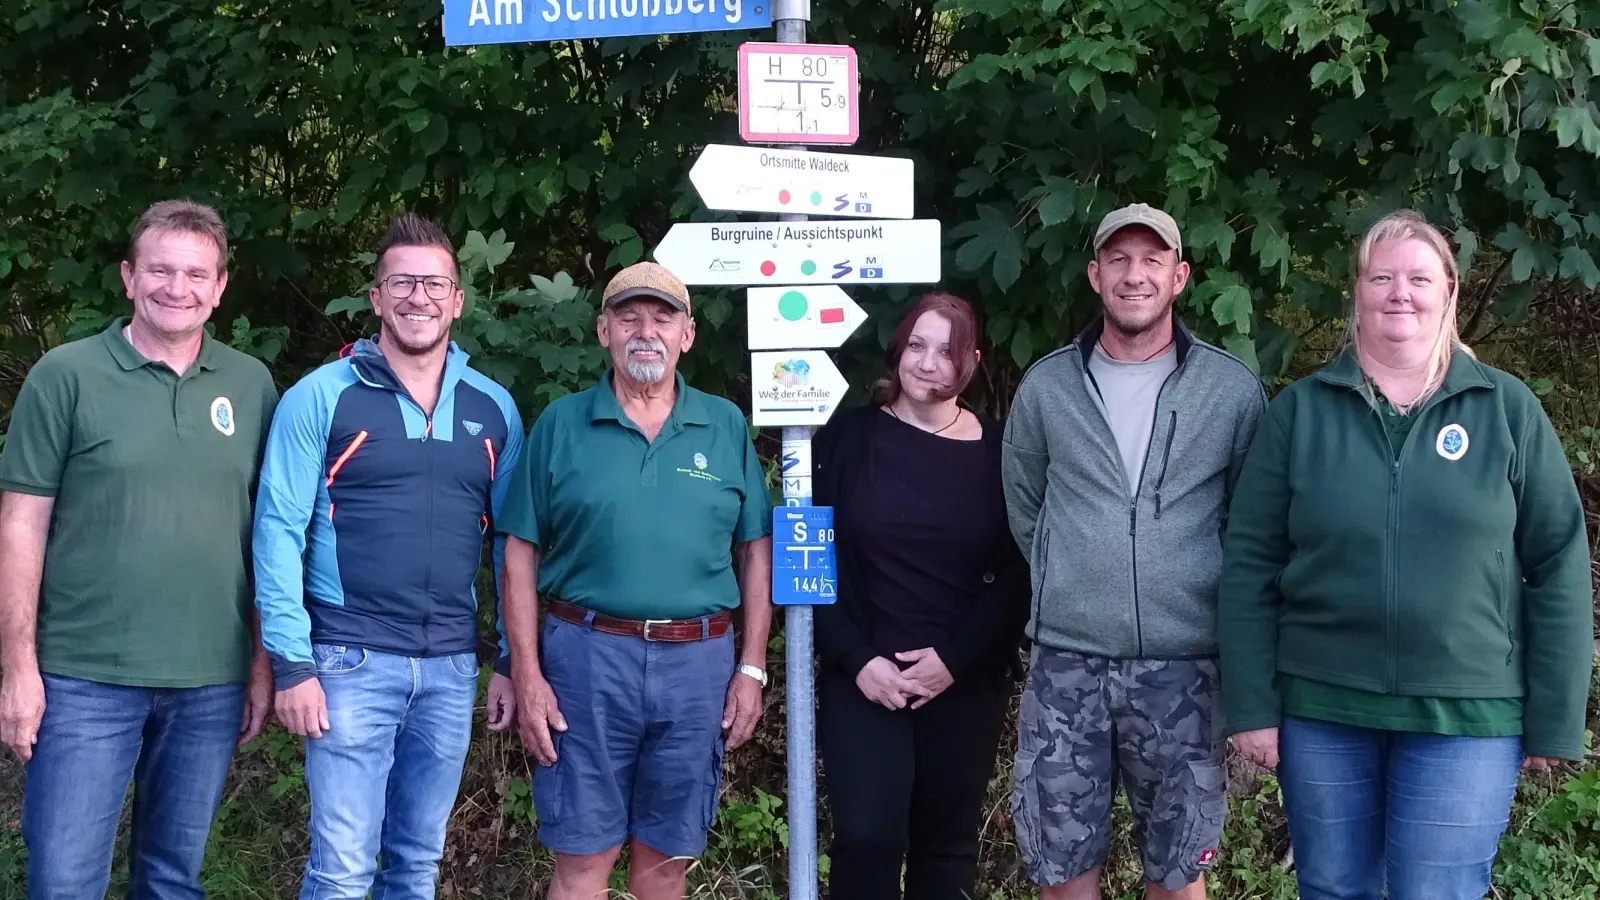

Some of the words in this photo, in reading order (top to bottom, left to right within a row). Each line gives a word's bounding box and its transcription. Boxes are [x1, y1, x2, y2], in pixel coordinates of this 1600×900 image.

[769, 56, 782, 76] H
[802, 57, 827, 77] 80
[760, 153, 806, 170] Ortsmitte
[809, 156, 850, 173] Waldeck
[711, 227, 774, 243] Burgruine
[784, 226, 883, 243] Aussichtspunkt
[866, 256, 876, 264] M
[867, 269, 876, 278] D
[759, 390, 779, 401] Weg
[781, 389, 795, 398] der
[797, 389, 830, 398] Familie
[793, 521, 808, 542] S
[818, 529, 834, 542] 80
